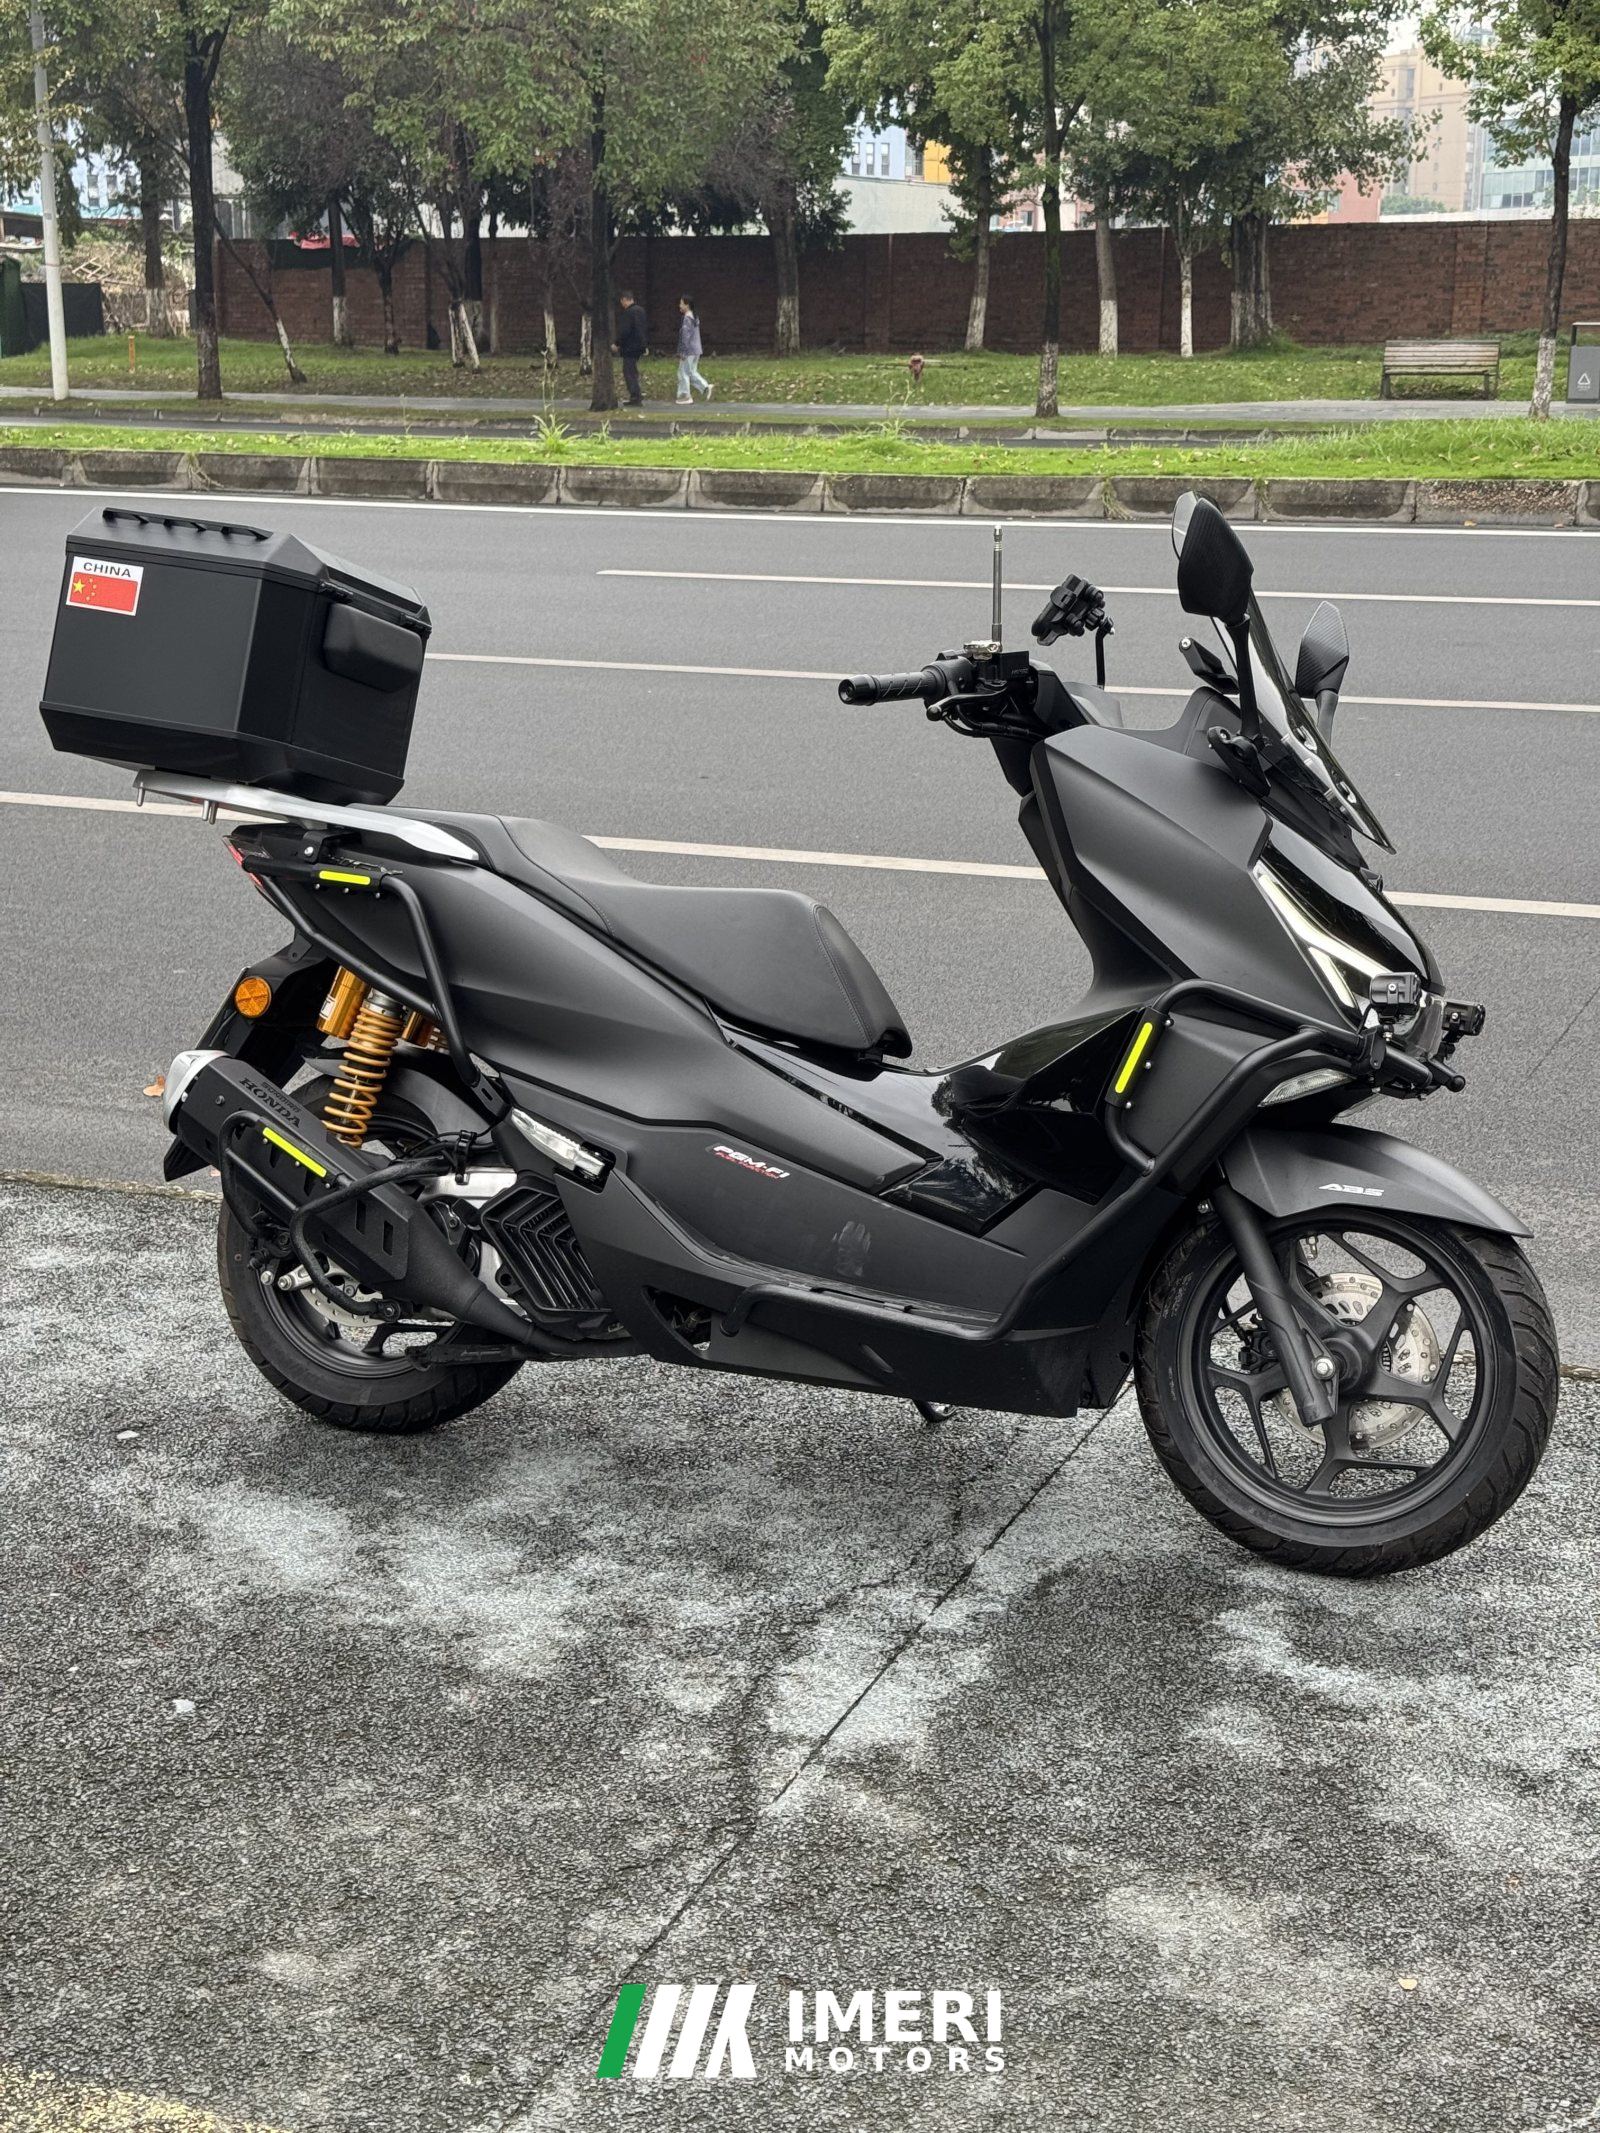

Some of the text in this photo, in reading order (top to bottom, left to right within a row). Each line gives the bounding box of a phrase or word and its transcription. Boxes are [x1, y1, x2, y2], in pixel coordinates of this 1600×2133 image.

[83, 562, 131, 578] CHINA
[239, 1077, 301, 1128] HONDA
[1318, 1183, 1384, 1197] ABS
